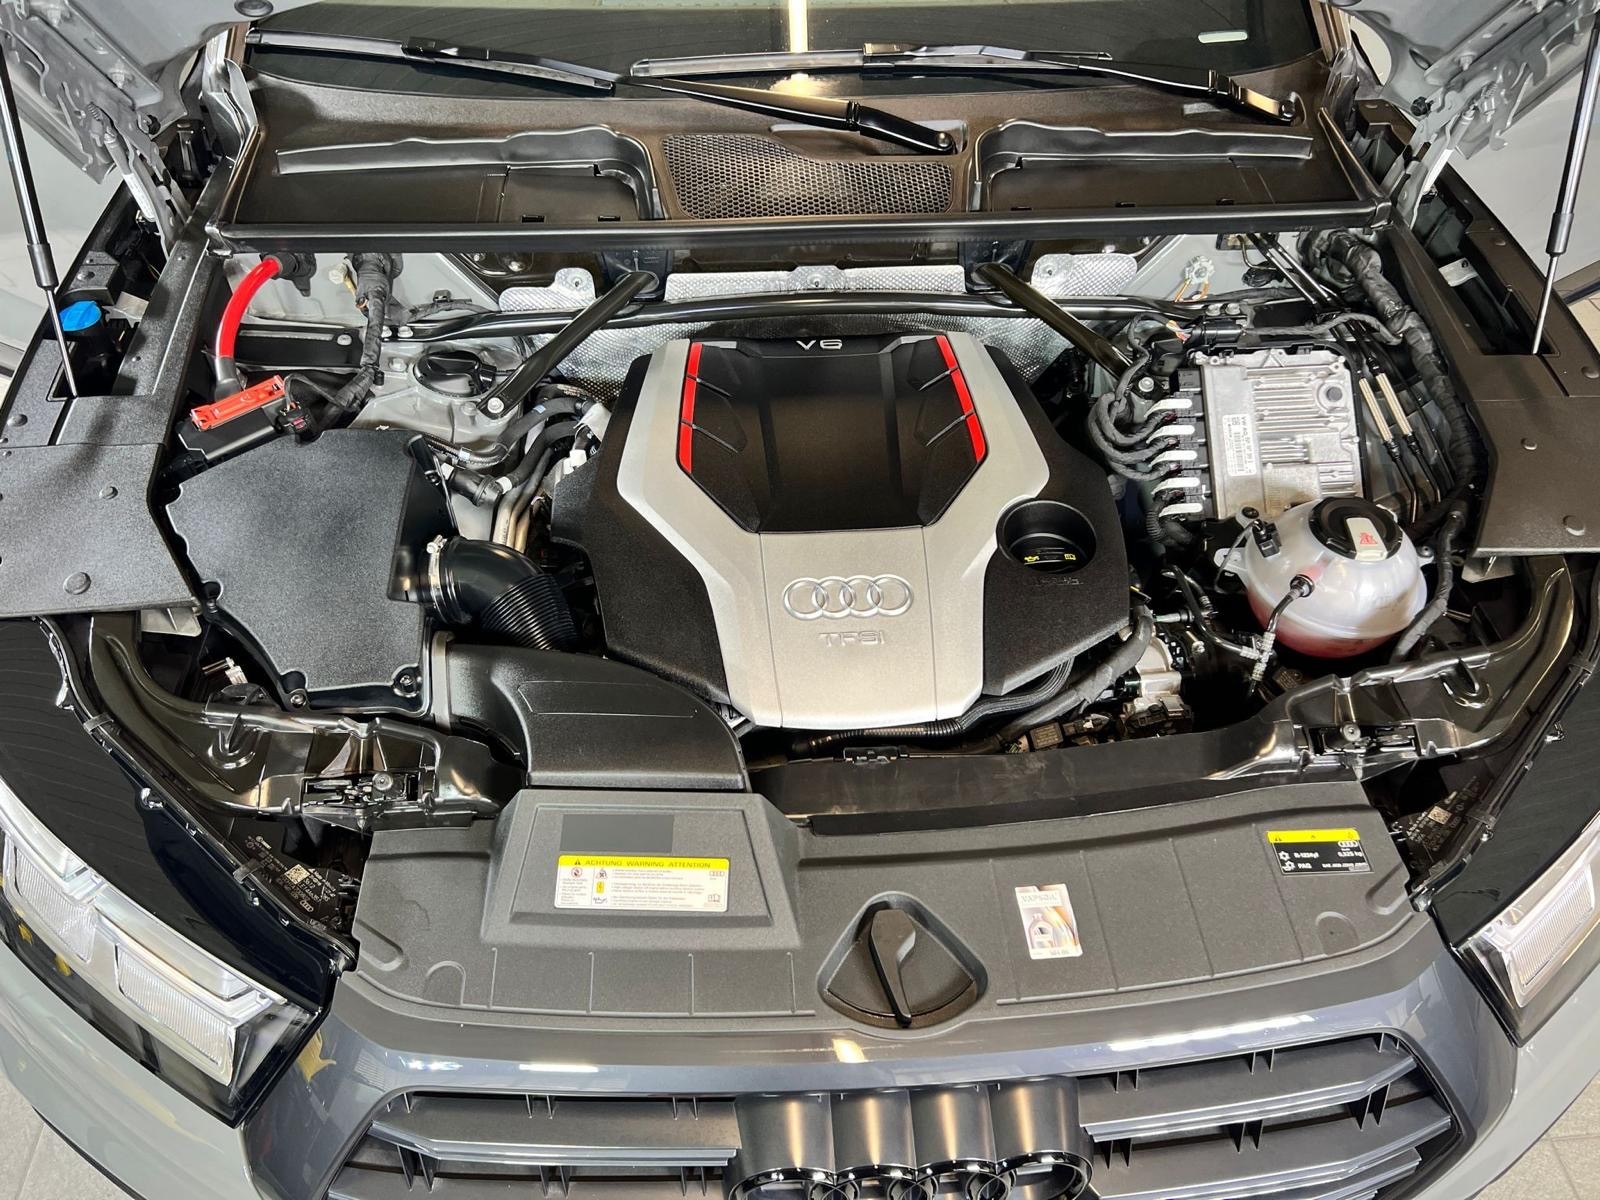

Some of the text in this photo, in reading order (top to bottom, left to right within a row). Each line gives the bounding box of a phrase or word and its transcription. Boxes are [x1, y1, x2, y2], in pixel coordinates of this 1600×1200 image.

[795, 338, 843, 350] V6
[818, 631, 886, 648] TFSI
[585, 859, 712, 869] ACHTUNG WARNING ATTENTION
